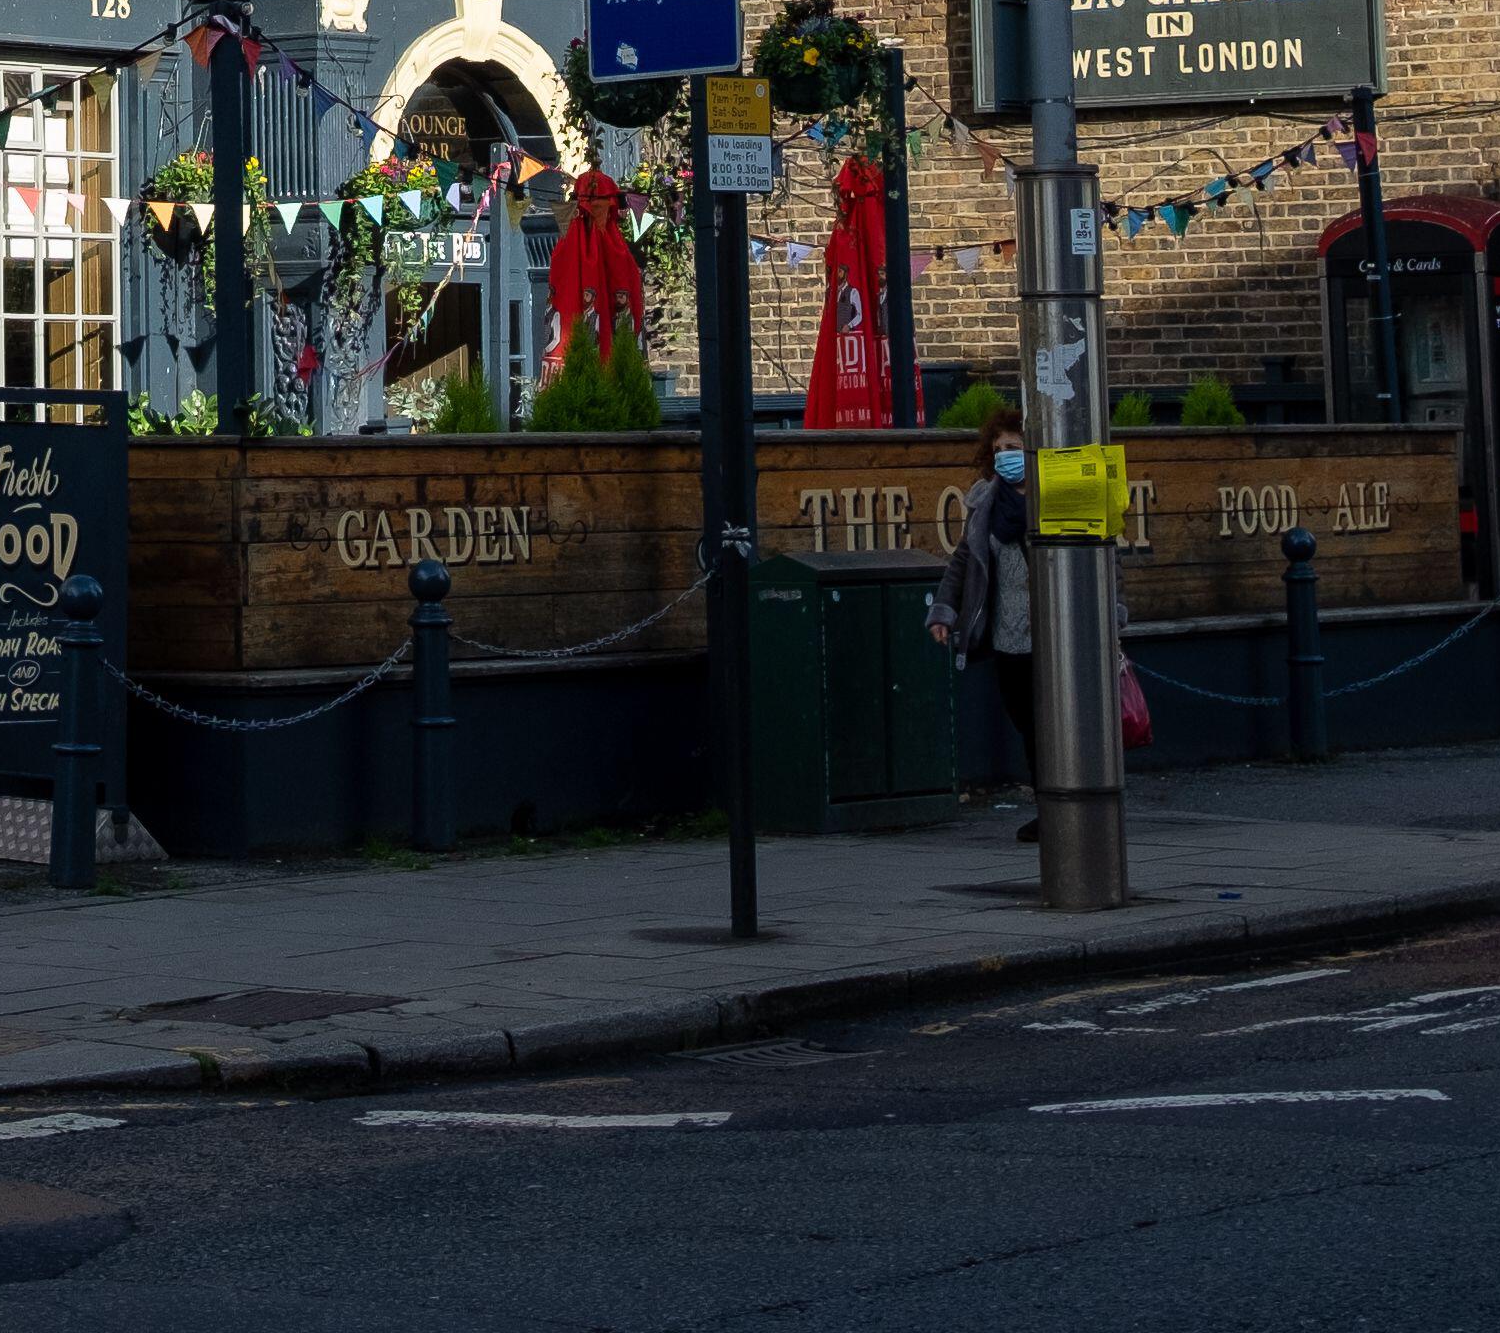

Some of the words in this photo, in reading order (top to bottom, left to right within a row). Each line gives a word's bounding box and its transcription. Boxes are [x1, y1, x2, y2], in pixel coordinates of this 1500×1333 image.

[1156, 15, 1185, 35] IN
[1072, 46, 1155, 79] WEST
[1179, 39, 1303, 73] LONDON
[717, 139, 729, 149] No
[733, 139, 763, 151] loading
[1406, 257, 1441, 271] Cards
[801, 486, 912, 552] THE
[1218, 483, 1299, 537] FOOD
[1332, 481, 1391, 531] ALE
[336, 505, 533, 568] GARDEN
[7, 609, 49, 630] Includes
[25, 631, 62, 657] ROA
[12, 666, 36, 679] AND
